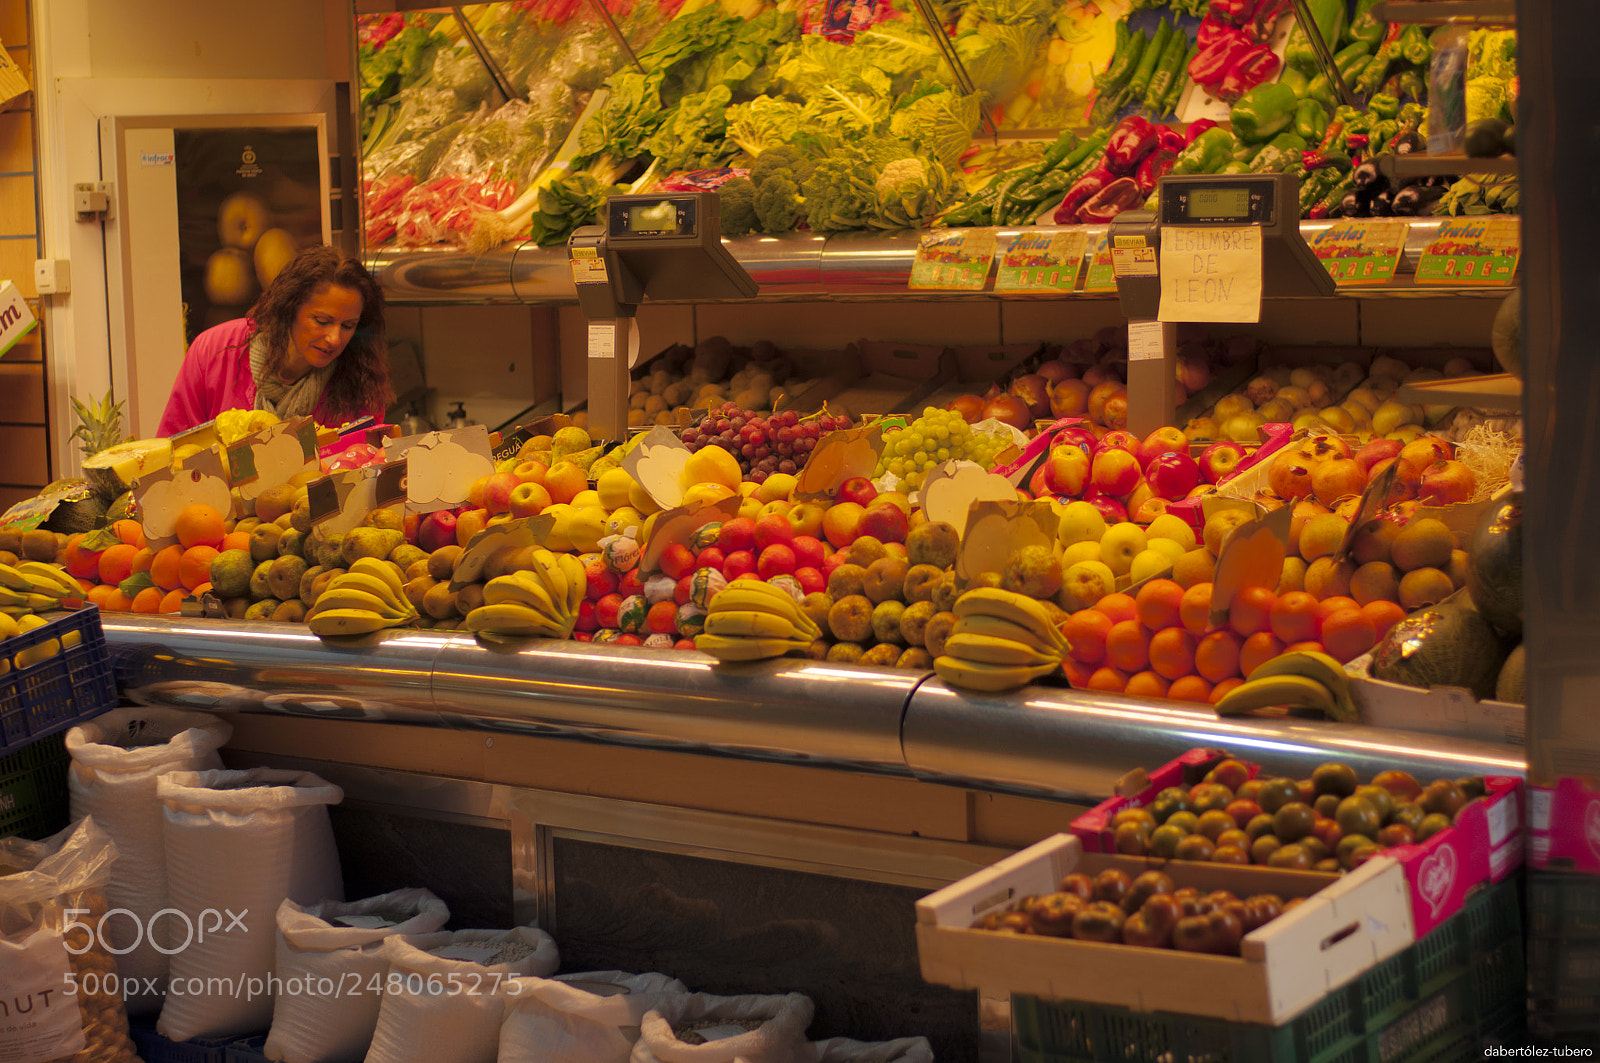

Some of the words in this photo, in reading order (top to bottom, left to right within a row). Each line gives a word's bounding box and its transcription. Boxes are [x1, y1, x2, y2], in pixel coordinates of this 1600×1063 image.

[1007, 234, 1052, 253] Frutas
[1164, 229, 1254, 252] LEGUMBRE
[1314, 225, 1366, 245] Frutas
[1193, 254, 1219, 275] DE
[1329, 261, 1374, 278] 2.25
[1444, 258, 1493, 277] 2.95
[1175, 277, 1234, 304] LEON
